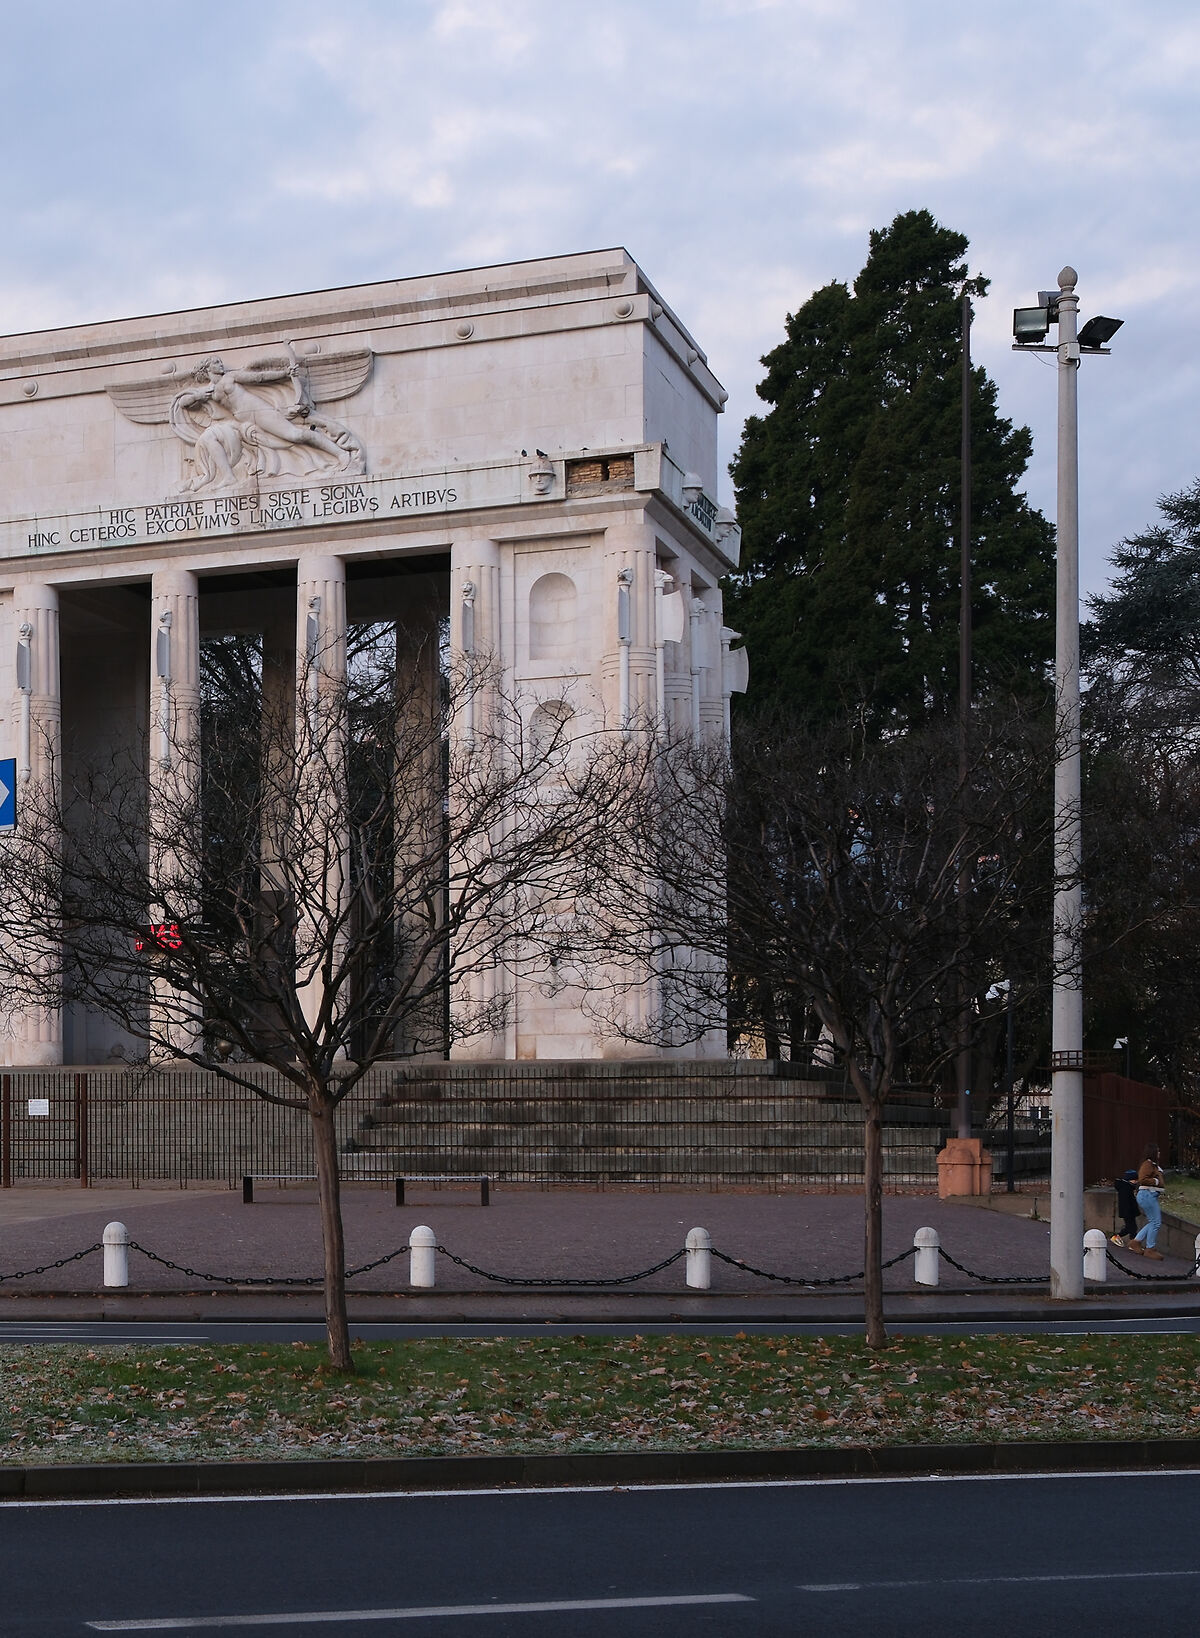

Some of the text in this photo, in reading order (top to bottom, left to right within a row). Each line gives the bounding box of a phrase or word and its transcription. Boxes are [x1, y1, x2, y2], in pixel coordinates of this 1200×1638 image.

[28, 488, 458, 548] HINC CETEROS EXCOLVIMVS LINGVA LEGIBVS ARTIBVS
[109, 484, 365, 525] HIC PATRIAE FINES SISTE SIGNA
